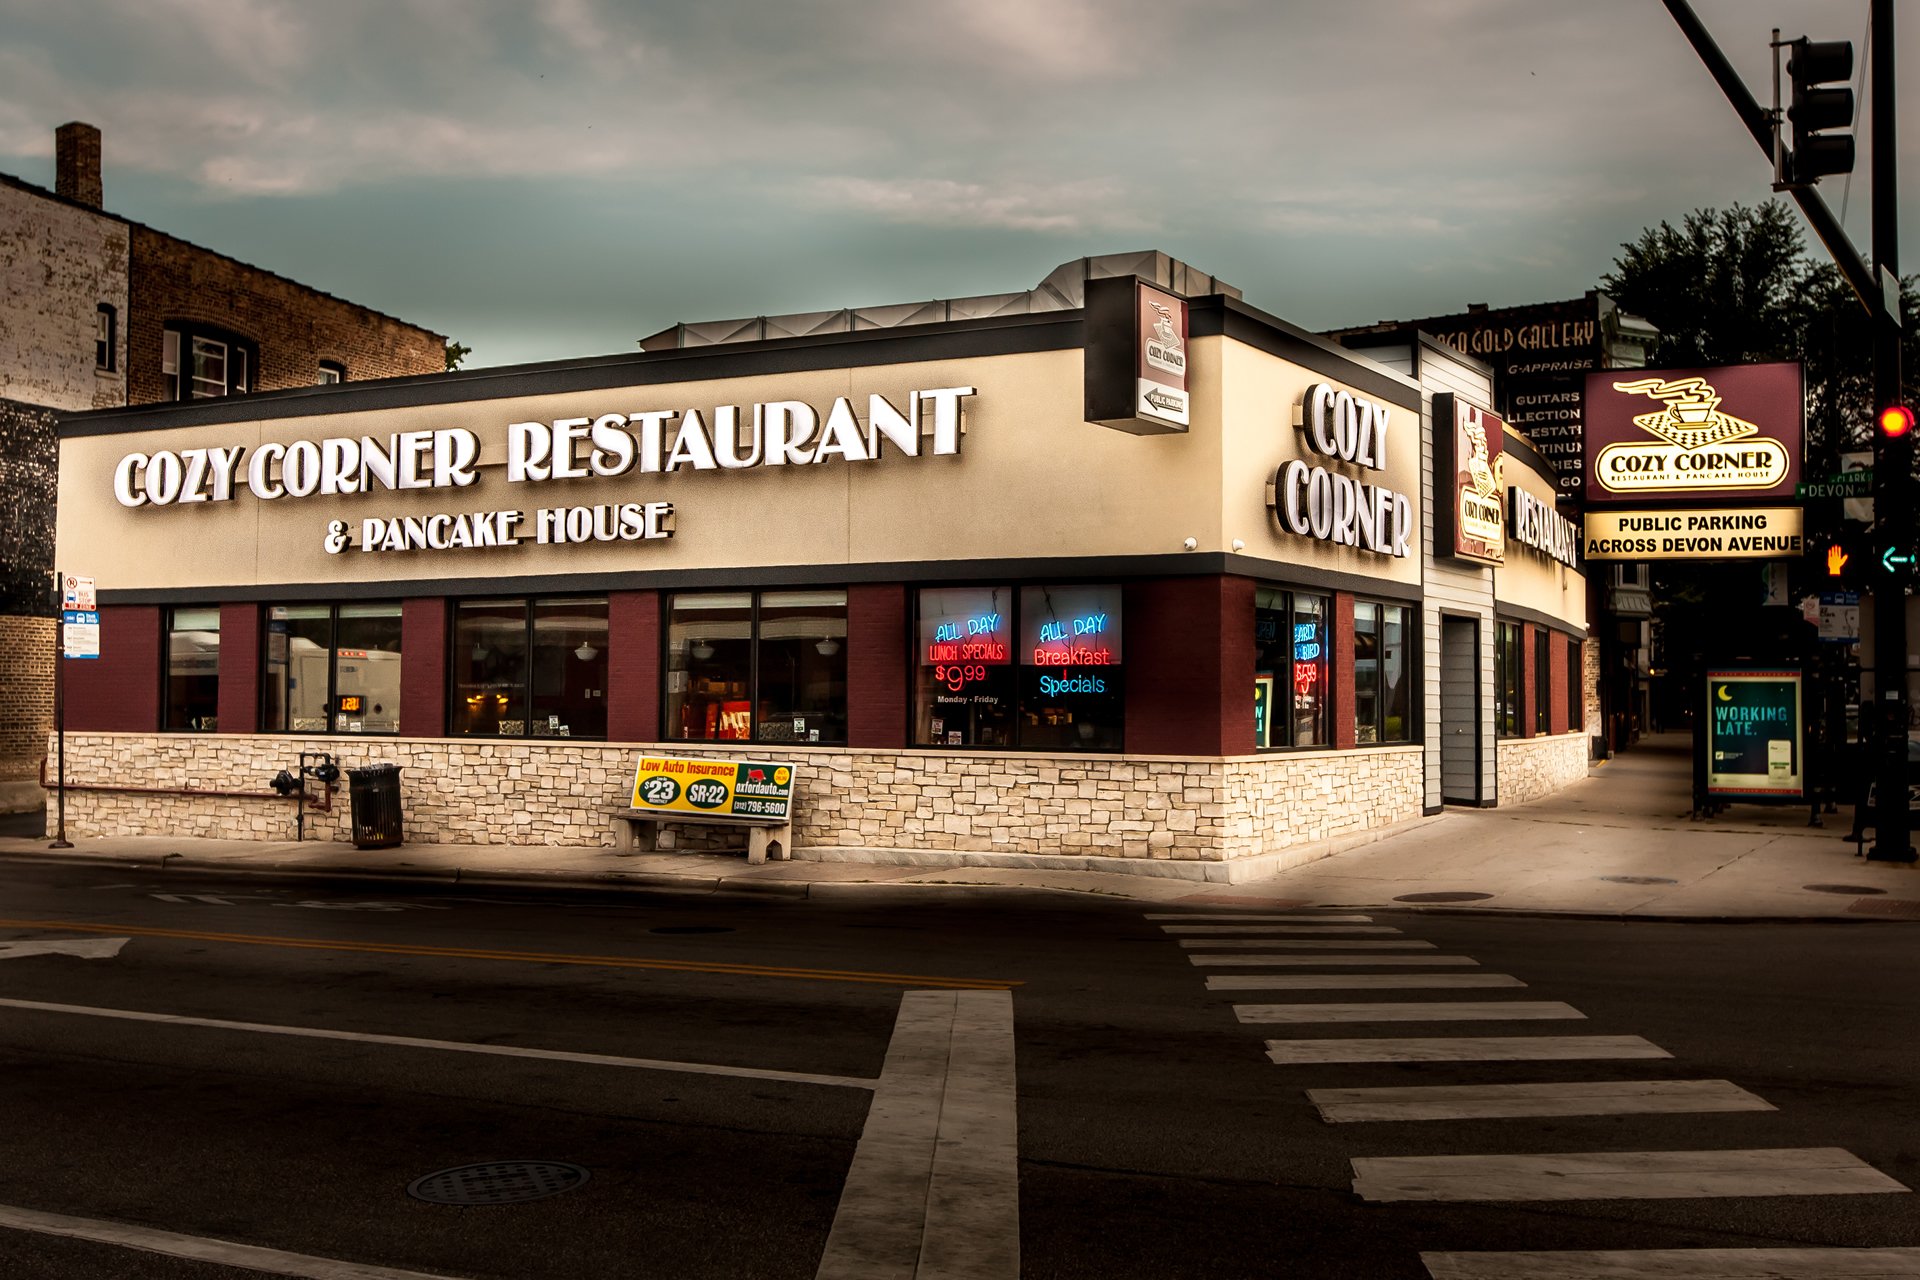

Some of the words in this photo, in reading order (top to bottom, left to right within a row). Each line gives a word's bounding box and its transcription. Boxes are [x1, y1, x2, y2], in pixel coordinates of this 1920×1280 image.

[1472, 328, 1514, 354] GOLD
[1518, 320, 1594, 349] GALLERY
[1516, 392, 1580, 406] GUITARS
[1303, 383, 1390, 471] COZY
[114, 445, 245, 507] COZY
[248, 428, 480, 499] CORNER
[508, 386, 977, 483] RESTAURANT
[1611, 454, 1667, 473] COZY
[1674, 451, 1772, 471] CORNER
[1687, 472, 1732, 480] PANCAKE
[1809, 484, 1854, 497] DEVON
[1275, 459, 1412, 558] CORNER
[324, 520, 352, 554] &
[362, 509, 523, 552] PANCAKE
[536, 502, 674, 545] HOUSE
[1510, 486, 1577, 569] RESTAURANT
[1619, 517, 1681, 532] PUBLIC
[1688, 515, 1767, 530] PARKING
[1587, 538, 1656, 554] ACROSS
[1663, 537, 1722, 552] DEVON
[1728, 536, 1800, 551] AVENUE
[935, 622, 962, 642] ALL
[968, 613, 998, 635] DAY
[1040, 621, 1068, 643] ALL
[1074, 614, 1106, 635] DAY
[929, 645, 957, 661] LUNCH
[963, 643, 1004, 660] SPECIALS
[1034, 647, 1110, 666] Breakfast
[1040, 674, 1105, 697] Specials
[938, 695, 967, 704] Monday
[974, 695, 998, 704] Friday
[1715, 706, 1787, 721] WORKING
[1716, 721, 1757, 736] LATE.
[641, 758, 660, 771] Low
[662, 760, 684, 773] Auto
[687, 762, 735, 776] Insurance
[644, 780, 675, 800] $23
[736, 781, 788, 795] oxfordauto.com
[734, 801, 747, 811] (312)
[747, 800, 785, 814] 796-5600
